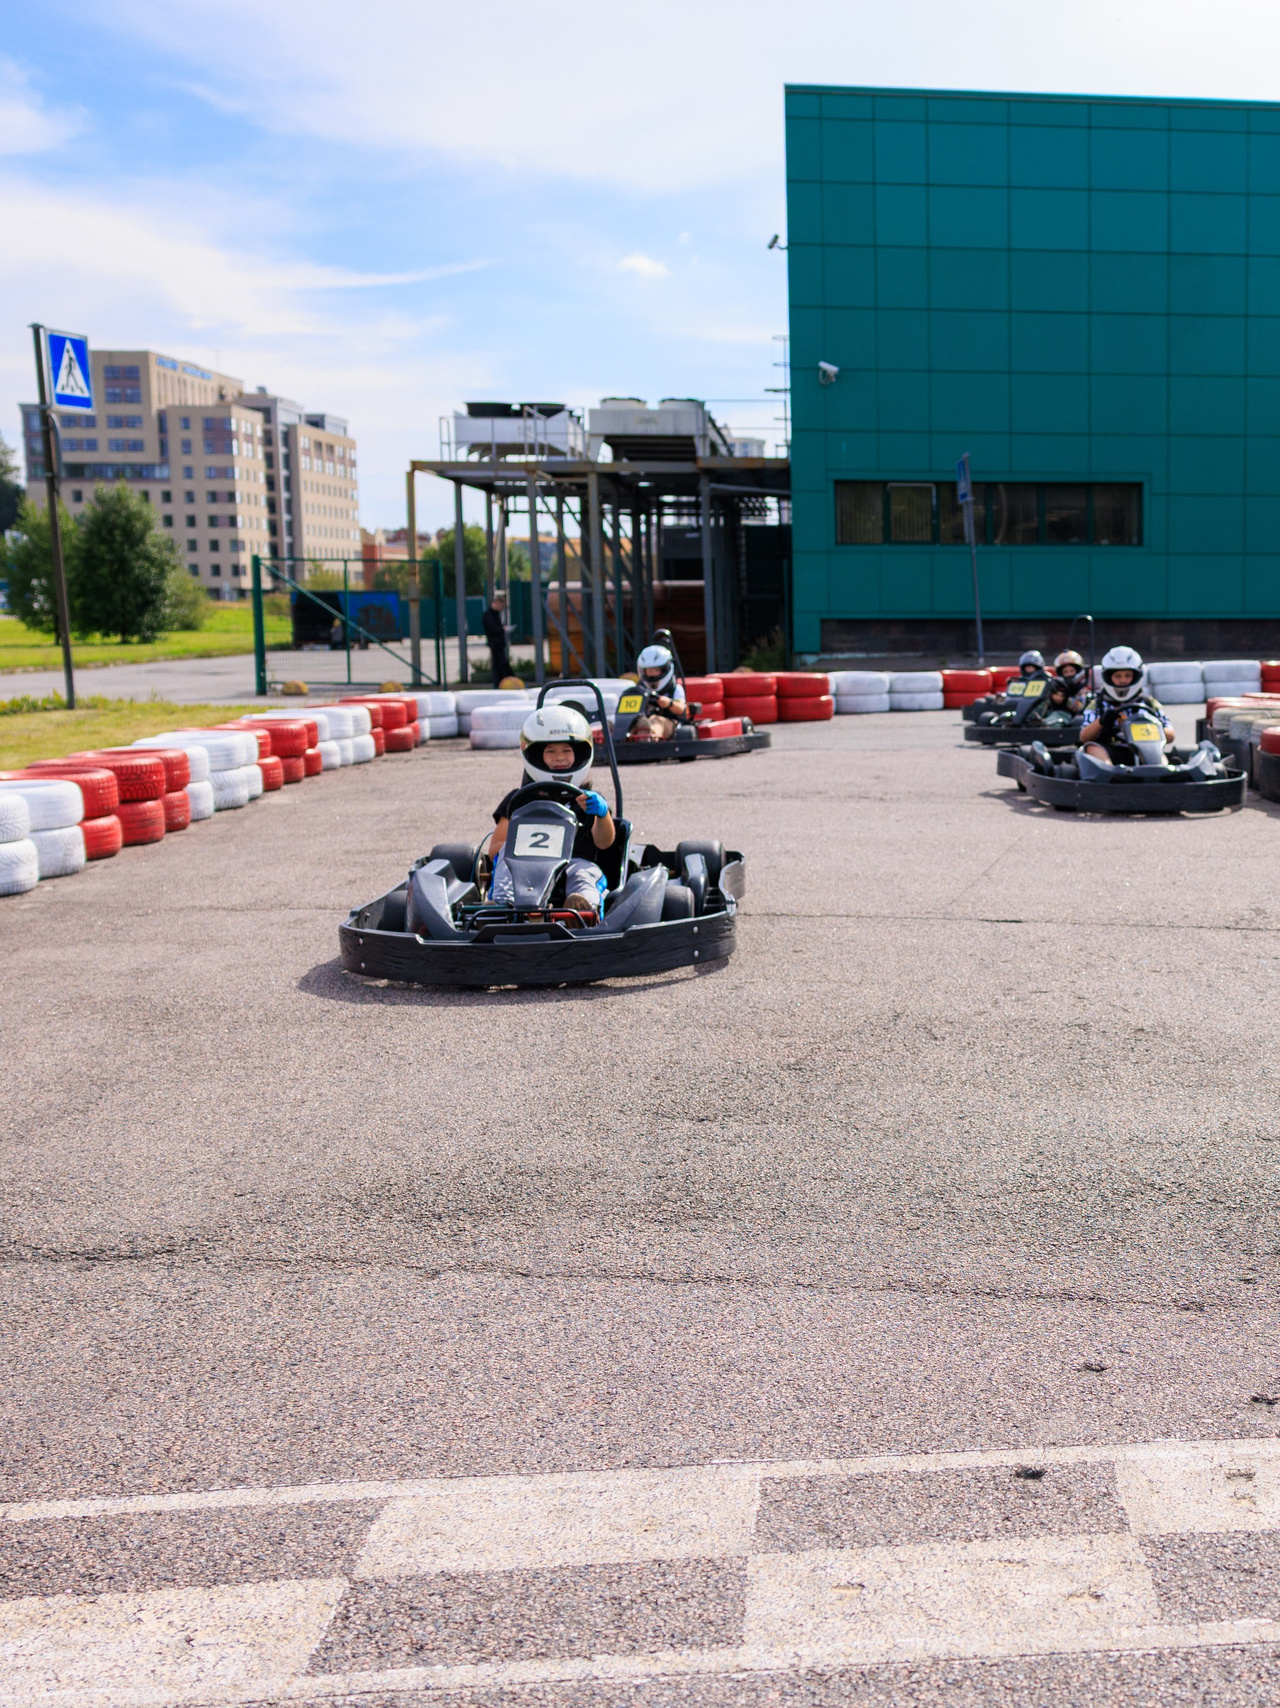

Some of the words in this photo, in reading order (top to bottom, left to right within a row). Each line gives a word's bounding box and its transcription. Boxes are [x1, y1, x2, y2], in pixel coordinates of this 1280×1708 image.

[625, 699, 637, 708] 10
[1140, 728, 1151, 736] 3
[528, 832, 550, 849] 2
